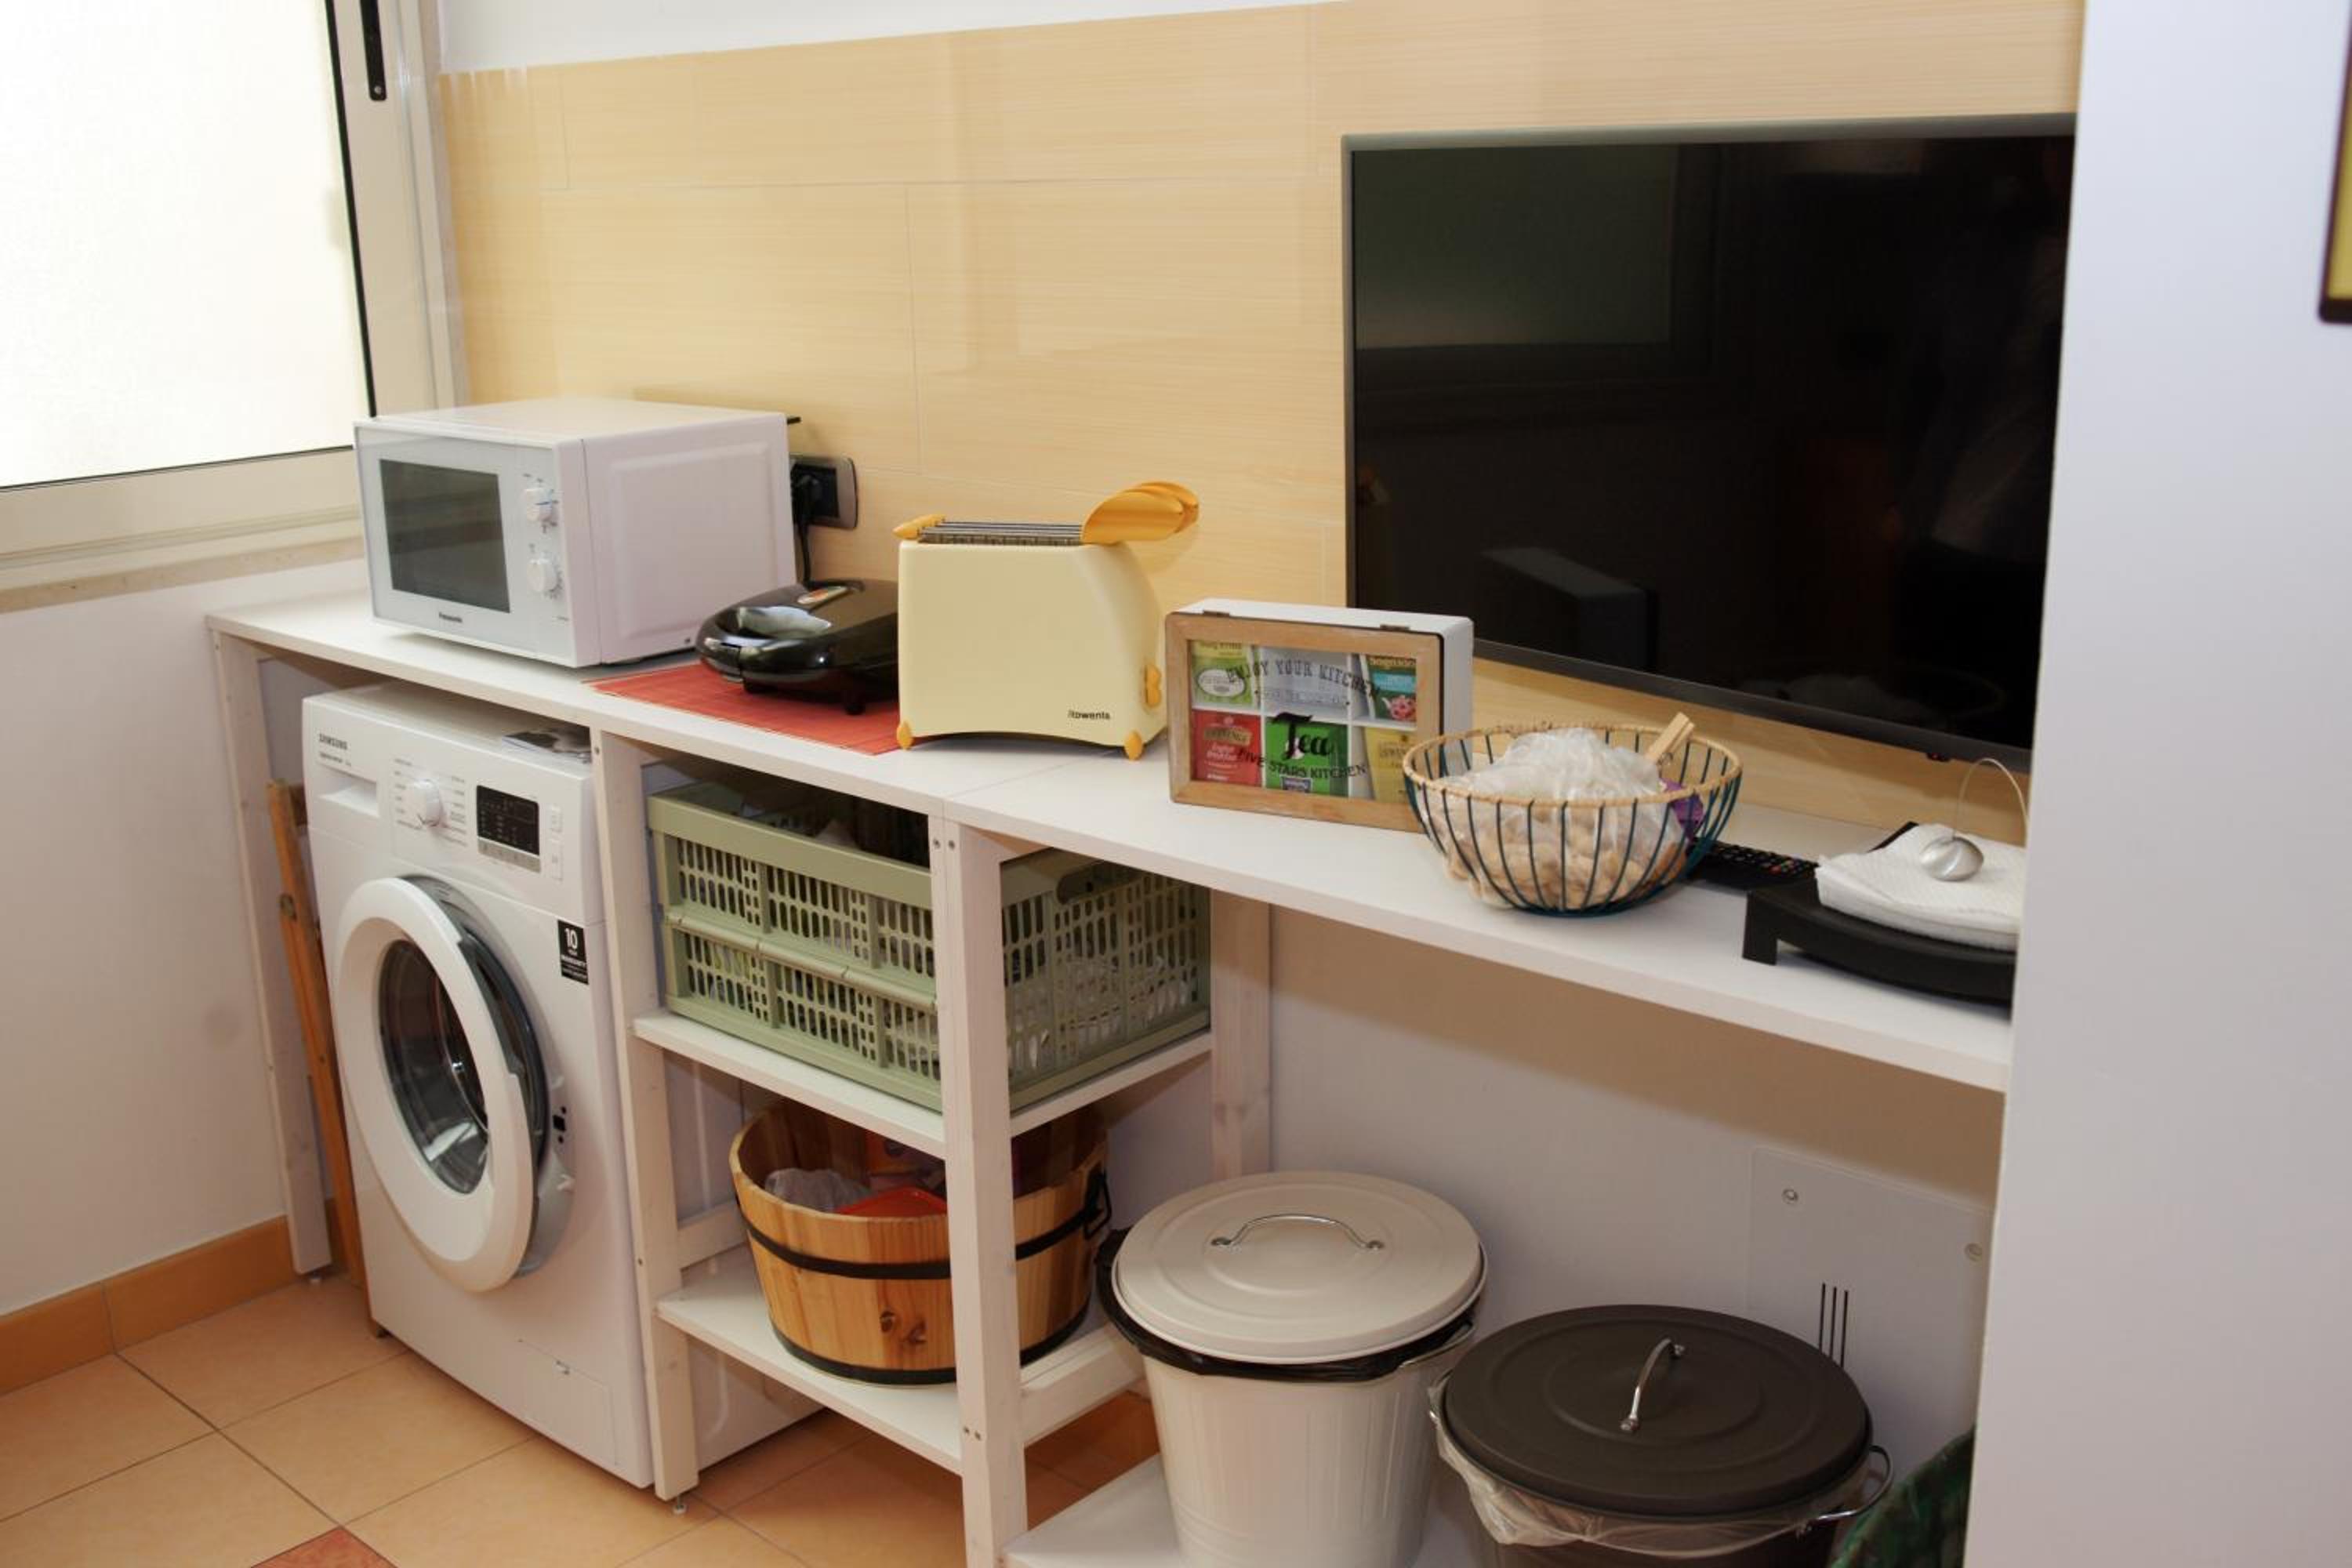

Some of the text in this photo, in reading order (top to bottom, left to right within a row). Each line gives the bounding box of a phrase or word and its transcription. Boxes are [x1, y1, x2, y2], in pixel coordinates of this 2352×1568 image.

[1226, 660, 1269, 684] ENJOY
[1276, 659, 1313, 677] YOUR
[1319, 664, 1380, 700] KITCHEN
[1067, 710, 1111, 720] Rowenta
[1272, 712, 1334, 760] Tea
[1236, 746, 1265, 768] FIVE
[1269, 759, 1308, 778] STARS
[1310, 764, 1367, 779] KITCHEN
[565, 927, 578, 949] 10
